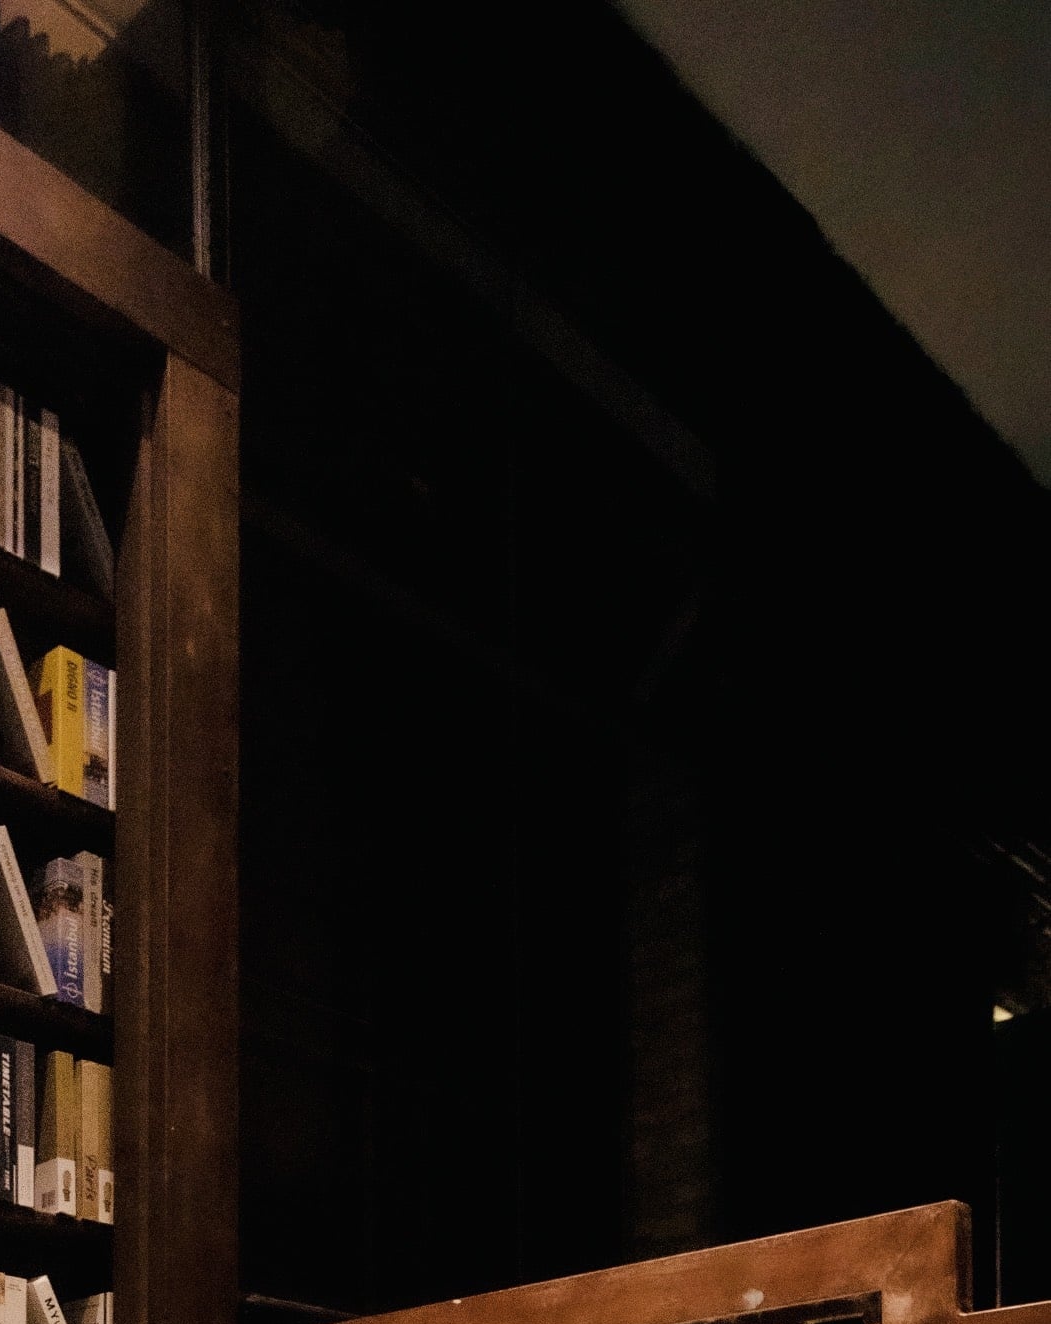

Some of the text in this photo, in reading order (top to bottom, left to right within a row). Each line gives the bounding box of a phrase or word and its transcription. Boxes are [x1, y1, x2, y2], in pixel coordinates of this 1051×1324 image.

[67, 660, 78, 700] DIGNO
[1, 1052, 11, 1138] TIMETABLE
[84, 1154, 98, 1202] Paris
